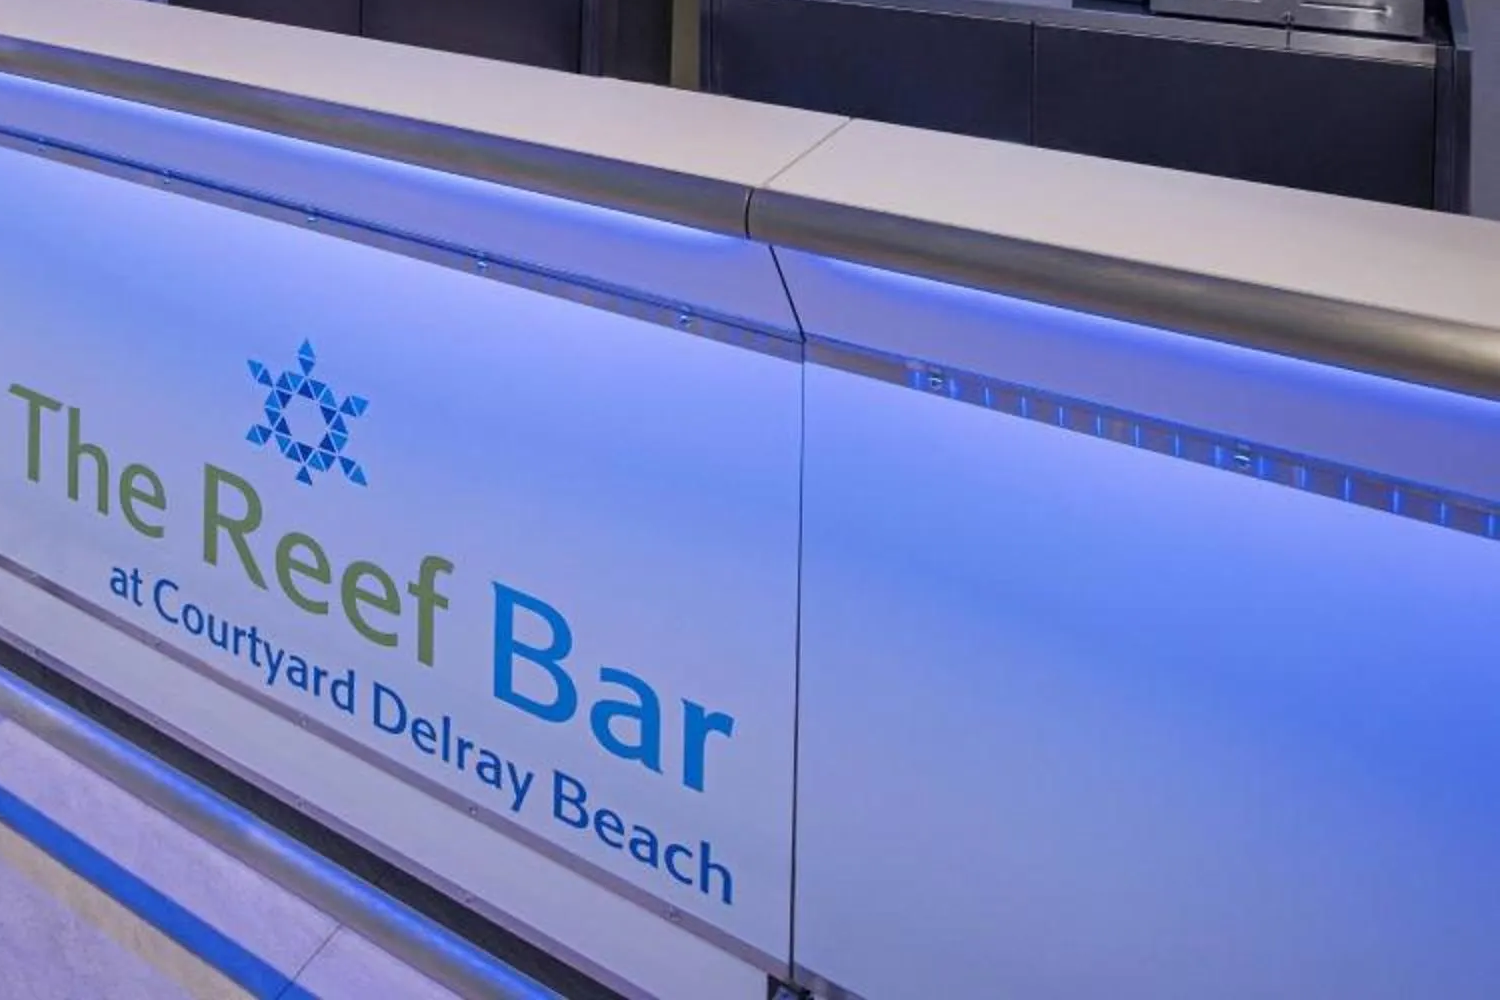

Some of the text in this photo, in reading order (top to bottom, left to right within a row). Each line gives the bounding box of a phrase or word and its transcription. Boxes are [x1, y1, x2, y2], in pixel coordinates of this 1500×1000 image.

[8, 383, 735, 793] The Reef Bar
[109, 566, 733, 906] at Courtyard Delray Beach
